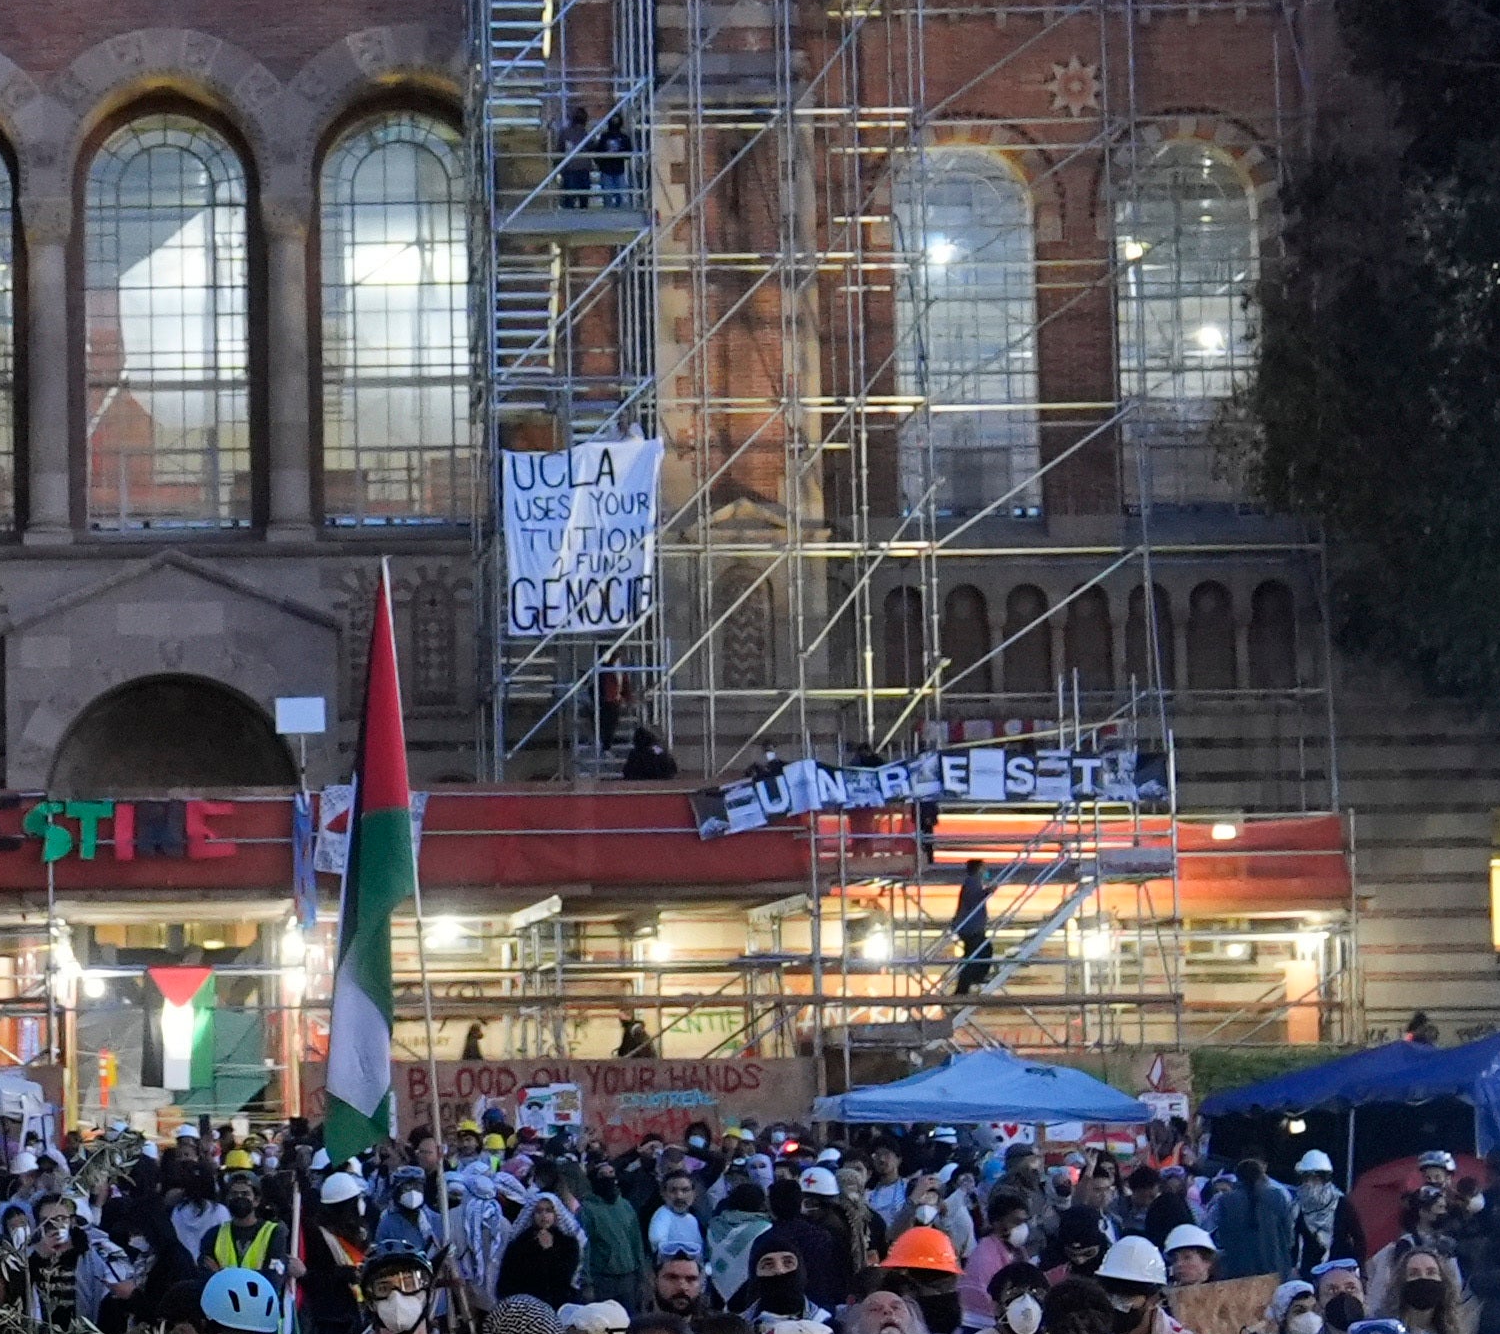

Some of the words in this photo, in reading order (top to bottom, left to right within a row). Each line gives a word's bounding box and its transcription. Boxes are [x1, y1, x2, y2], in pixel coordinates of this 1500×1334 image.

[511, 445, 615, 491] UCLA
[514, 494, 571, 522] USES
[588, 491, 650, 516] YOUR
[520, 526, 645, 553] TUITION
[552, 556, 574, 579] 2
[576, 553, 633, 574] FUND
[407, 1066, 518, 1100] BLOOD
[586, 1065, 657, 1096] YOUR
[664, 1063, 764, 1094] HANDS
